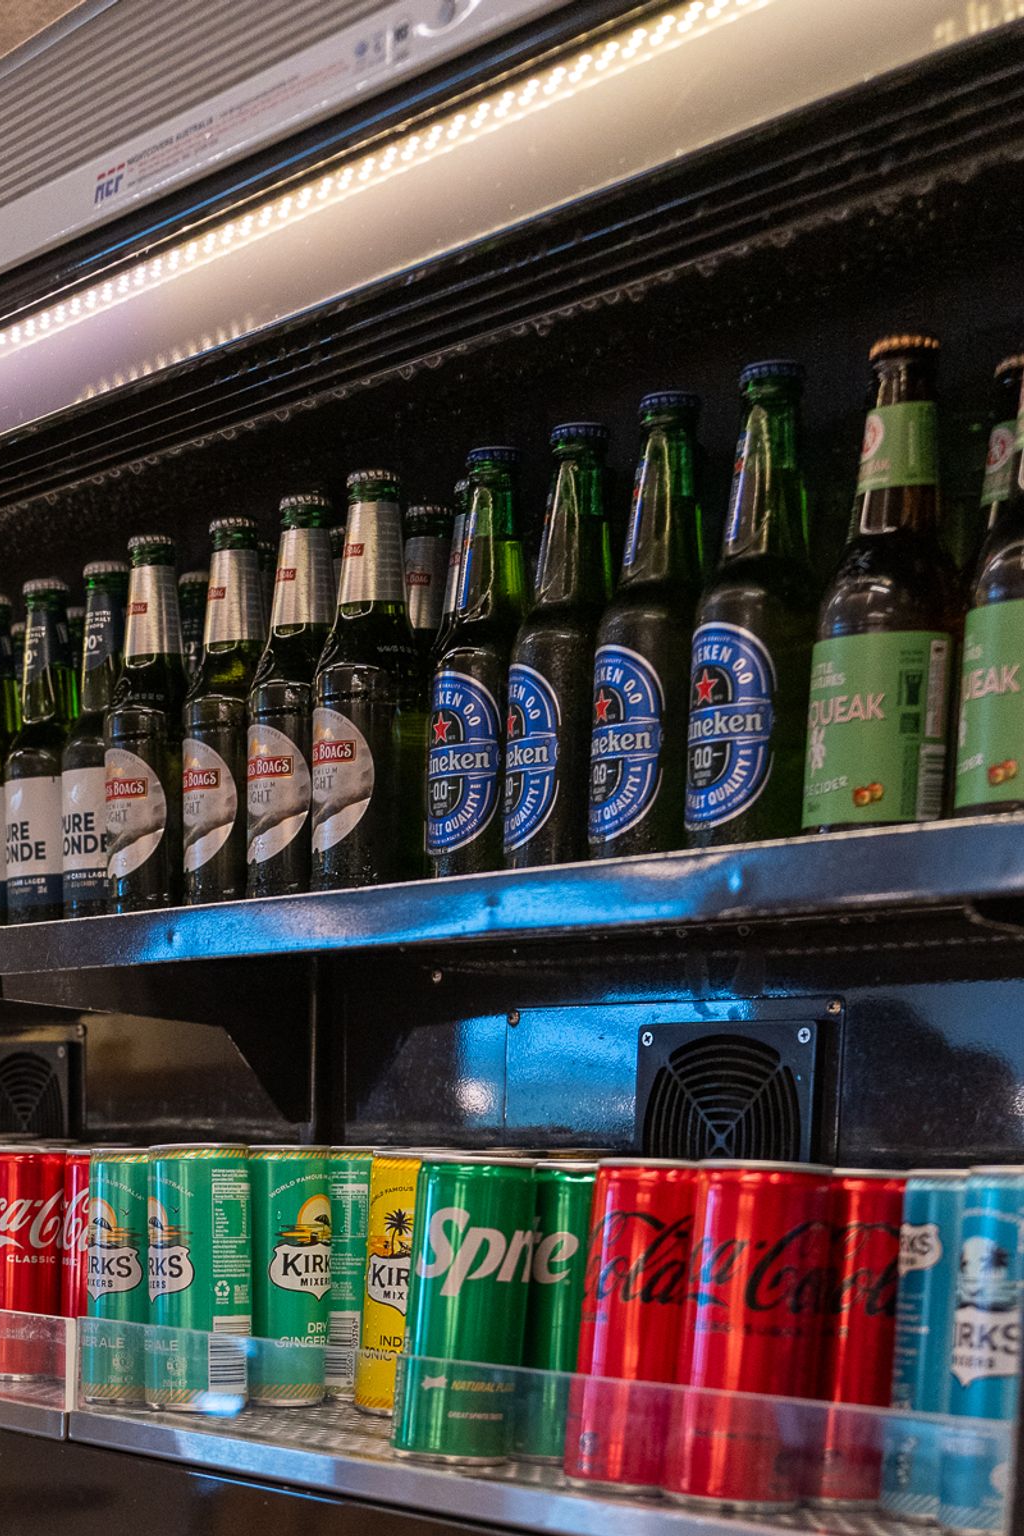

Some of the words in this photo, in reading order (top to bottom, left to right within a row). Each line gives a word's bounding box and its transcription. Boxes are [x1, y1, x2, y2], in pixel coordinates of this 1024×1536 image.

[707, 757, 752, 807] QUALITY
[602, 775, 642, 819] QUALITY
[444, 789, 481, 833] QUALITY
[509, 787, 541, 831] QUALITY
[269, 1181, 297, 1199] WORLD
[295, 1174, 325, 1185] FAMOUS
[384, 1185, 415, 1195] FAMOUS
[6, 1254, 56, 1264] CLASSIC
[98, 1337, 125, 1349] ALE
[275, 1335, 328, 1349] GINGER
[379, 1335, 403, 1348] IND
[451, 1379, 495, 1393] NATURAL
